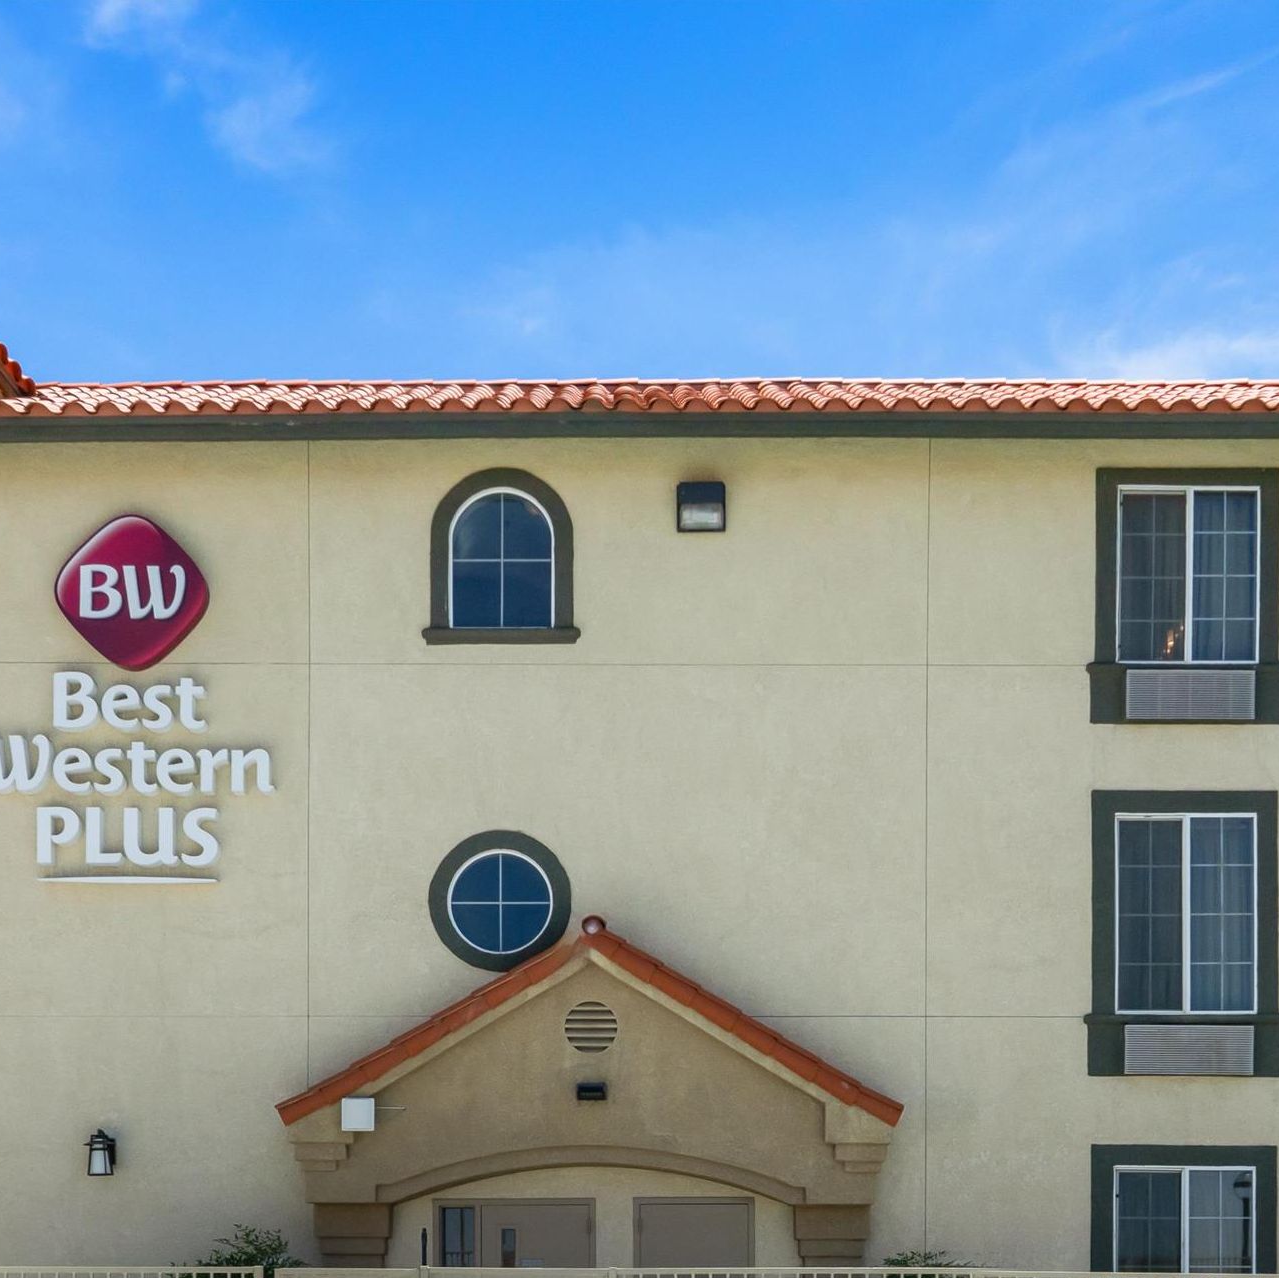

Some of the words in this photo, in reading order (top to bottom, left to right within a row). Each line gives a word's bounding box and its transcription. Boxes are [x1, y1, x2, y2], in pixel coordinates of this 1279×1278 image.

[78, 563, 187, 621] BW
[52, 671, 208, 733] Best
[35, 806, 220, 868] PLUS
